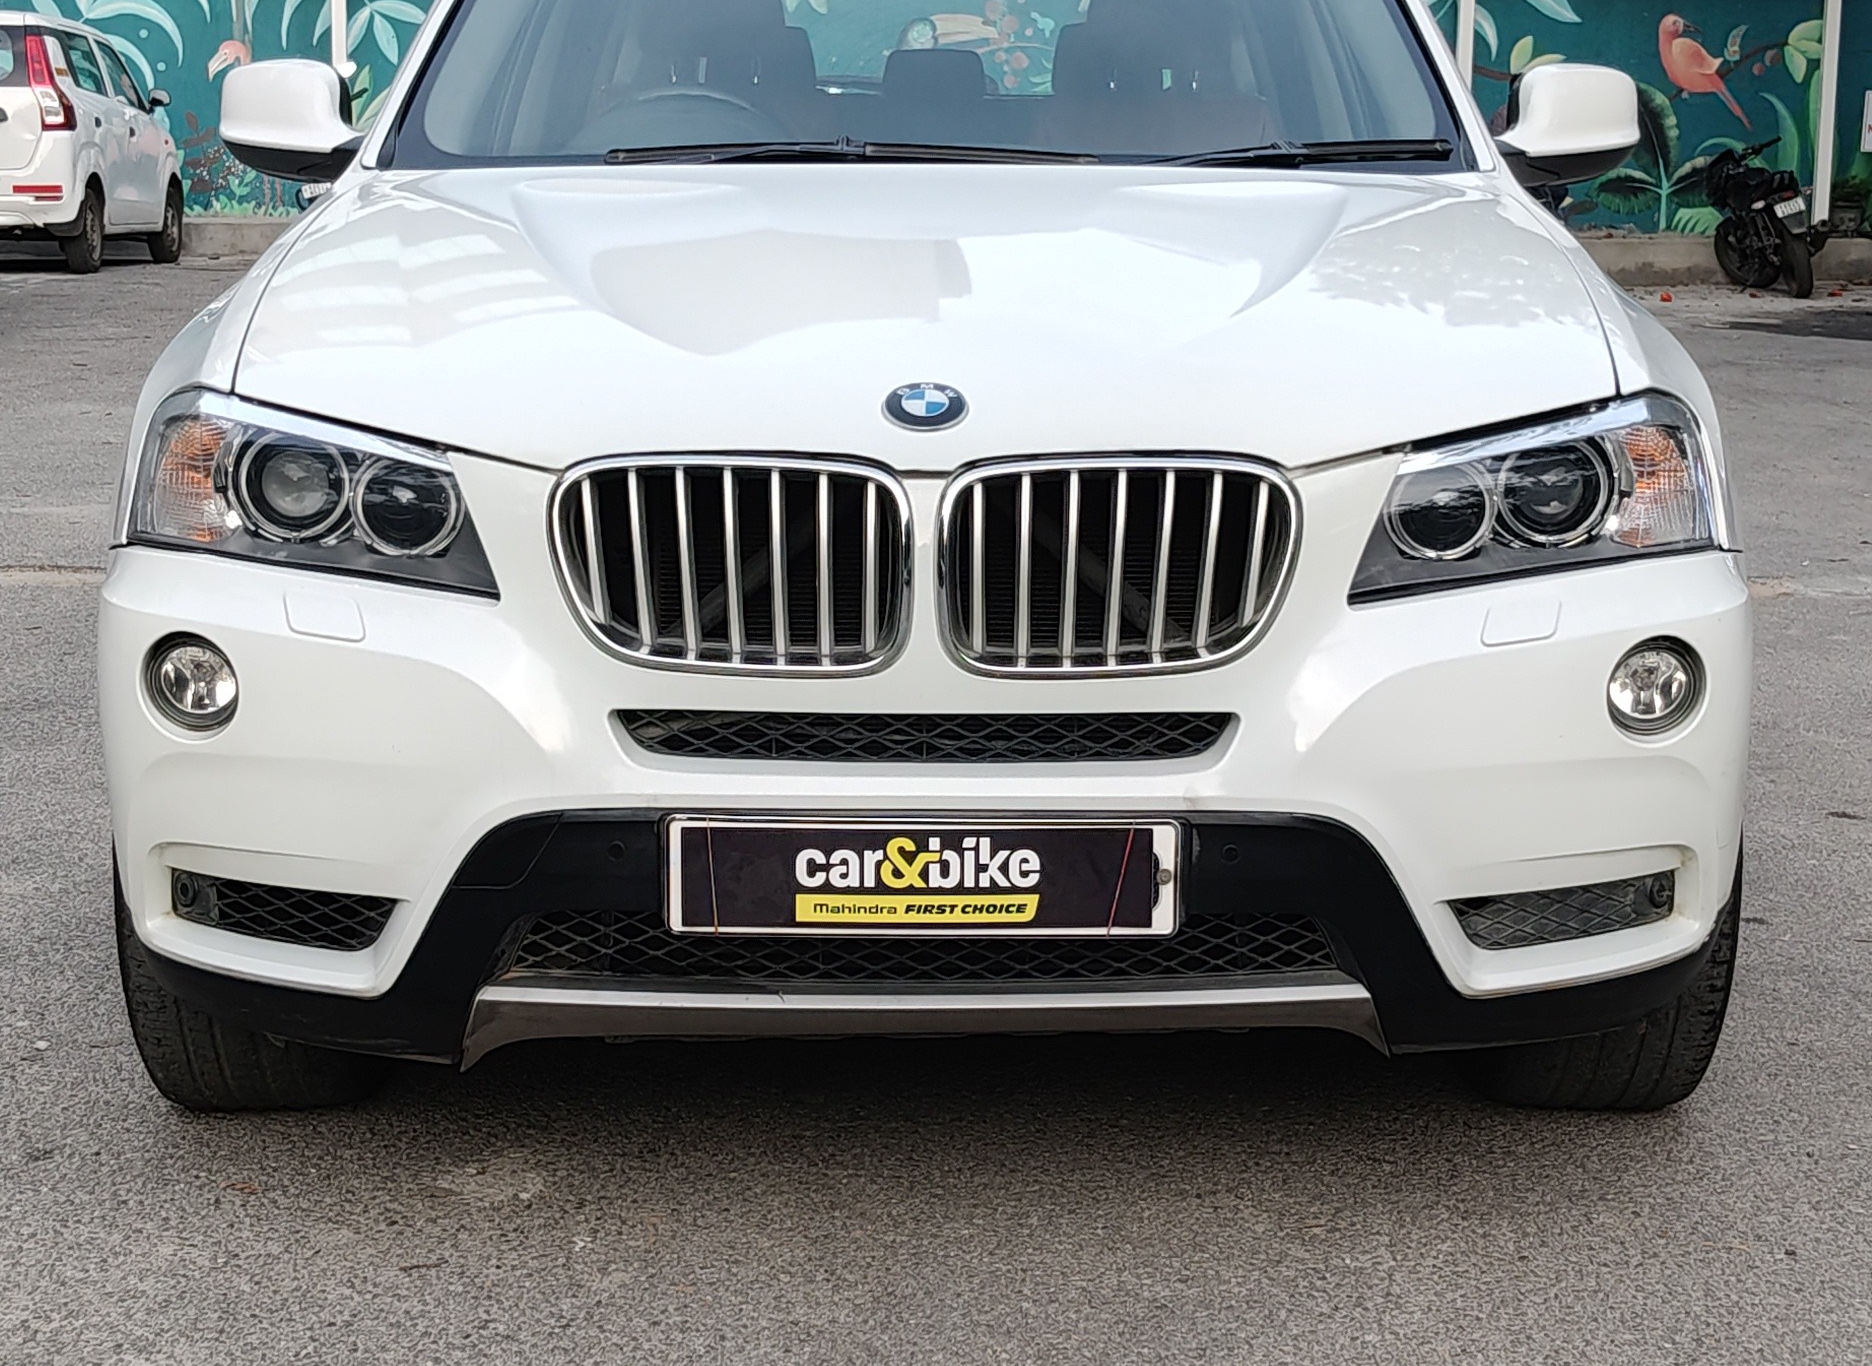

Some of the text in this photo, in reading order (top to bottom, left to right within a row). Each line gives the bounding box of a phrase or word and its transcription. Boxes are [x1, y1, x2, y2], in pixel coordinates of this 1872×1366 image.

[794, 836, 1042, 889] car&bike
[813, 902, 1029, 916] Mahindra FIRST CHOICE
